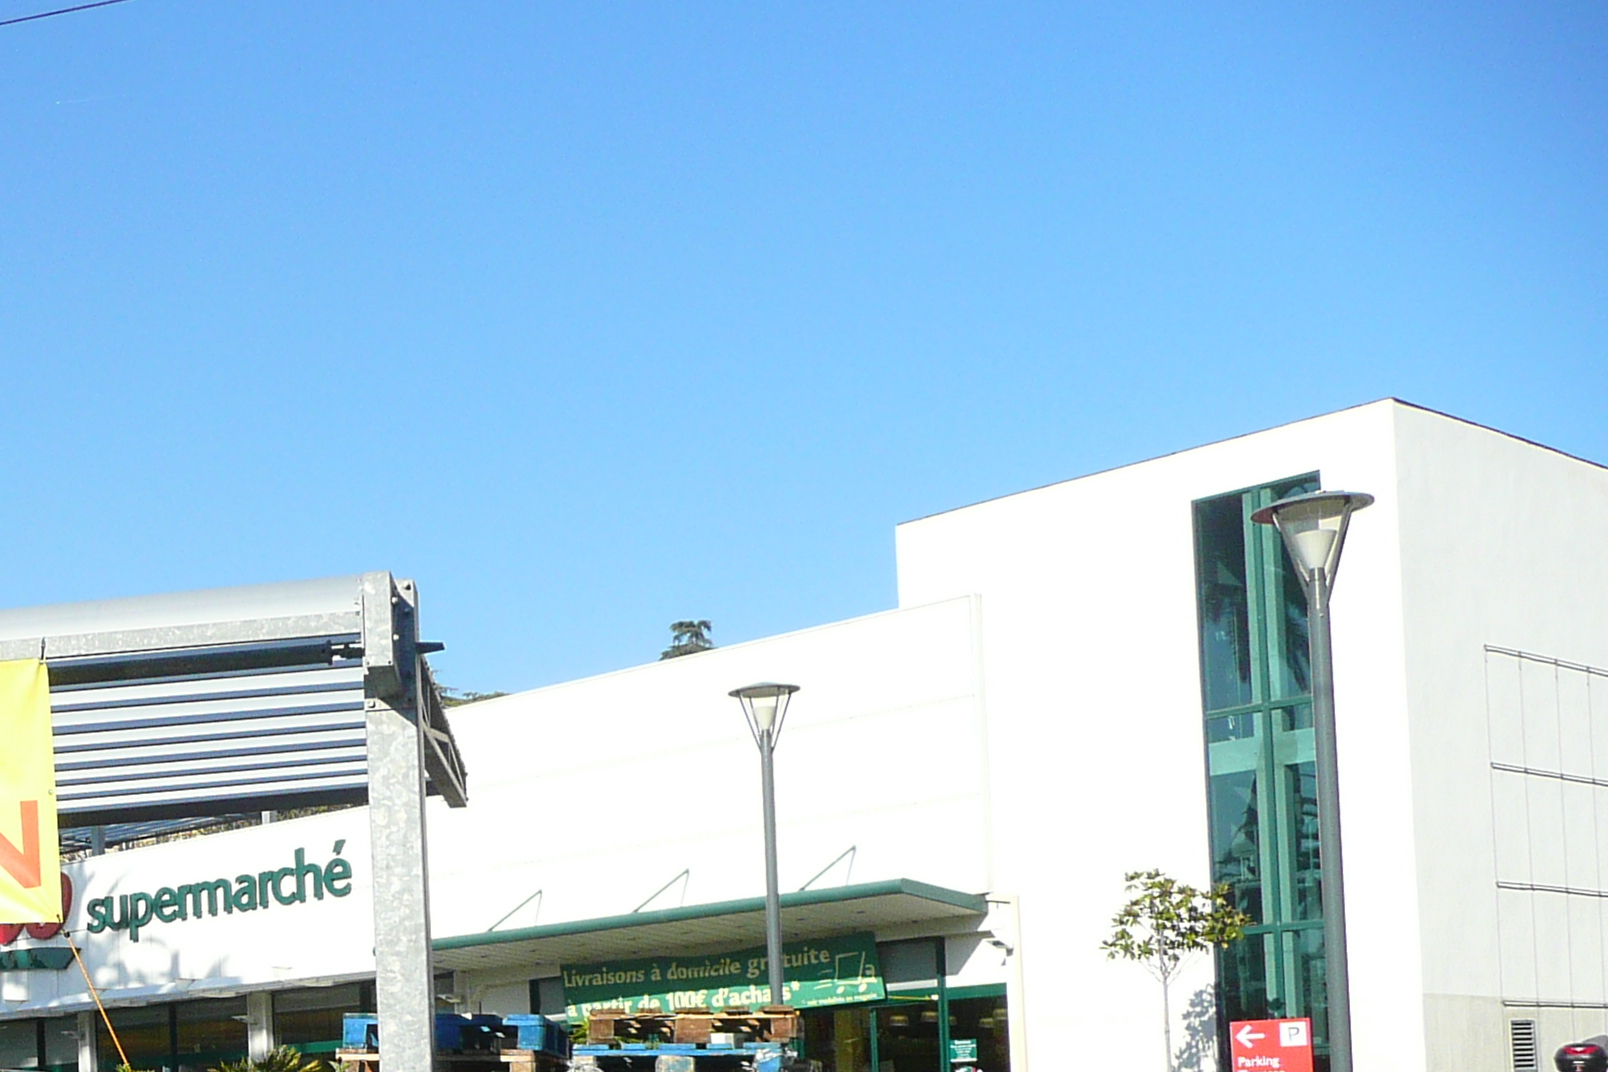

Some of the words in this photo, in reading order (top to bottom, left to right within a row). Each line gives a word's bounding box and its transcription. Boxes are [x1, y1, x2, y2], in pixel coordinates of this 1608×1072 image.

[87, 839, 352, 943] supermarché
[563, 966, 645, 987] Livraisons
[651, 963, 661, 981] à
[667, 958, 741, 980] domicile
[747, 946, 831, 979] grtuite
[666, 989, 708, 1011] 100€
[712, 981, 801, 1008] d'achas
[1288, 1026, 1300, 1042] P
[1237, 1055, 1280, 1068] Parking
